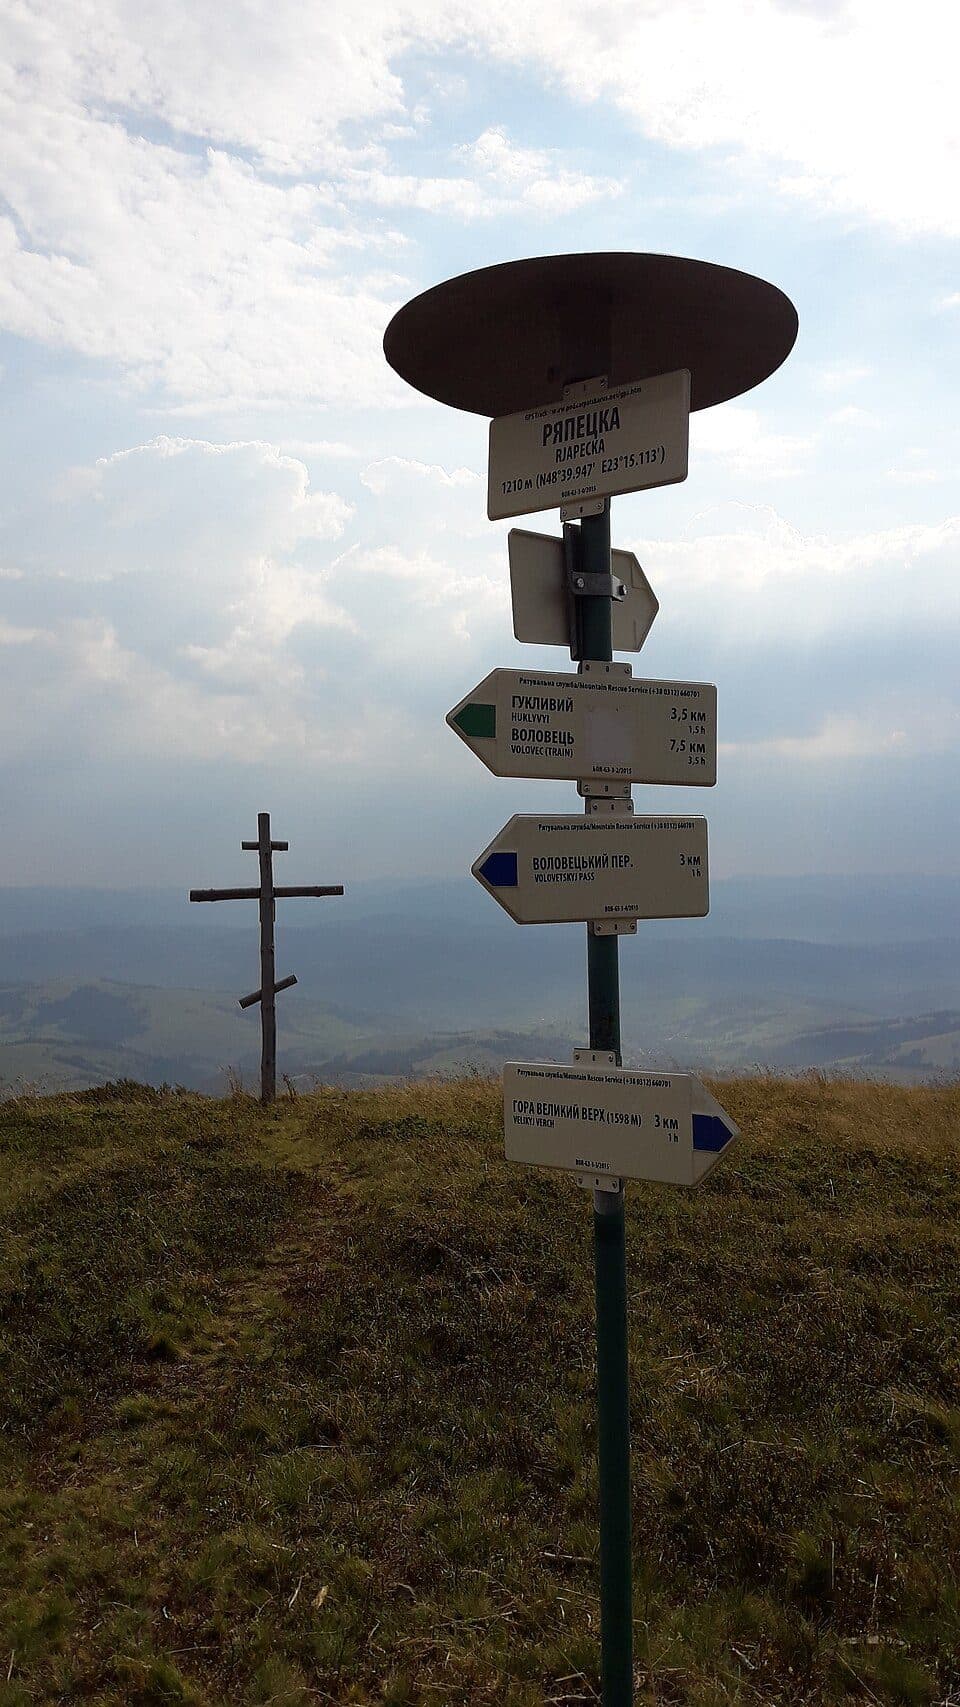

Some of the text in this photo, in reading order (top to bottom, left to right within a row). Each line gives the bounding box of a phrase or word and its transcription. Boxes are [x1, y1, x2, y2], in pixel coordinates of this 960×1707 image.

[542, 406, 620, 447] РЯПЕЦКА
[555, 439, 605, 463] RJAPECKA
[502, 479, 523, 494] 1210
[628, 686, 648, 694] Service
[512, 695, 574, 713] ГУКЛИВИЙ
[670, 707, 688, 722] 3,5
[511, 728, 575, 746] ВОЛОВЕЦЬ
[670, 739, 686, 752] 7,5
[688, 726, 699, 735] 1,5
[700, 726, 705, 734] h
[511, 745, 705, 765] VOLOVEC (TRAIN) 3,5 h
[532, 852, 609, 871] ВОЛОВЕЦЬКИЙ
[611, 854, 633, 868] ПЕР.
[679, 853, 686, 866] 3
[534, 872, 578, 883] VOLOVETSKYJ
[578, 871, 595, 881] PASS
[696, 869, 701, 877] h
[604, 1075, 622, 1083] Service
[513, 1100, 534, 1114] ГОРА
[536, 1102, 579, 1119] ВЕЛИКИЙ
[582, 1107, 606, 1122] ВЕРХ
[654, 1114, 660, 1128] 3
[513, 1115, 679, 1142] VELIKYJ VERCH 1 h
